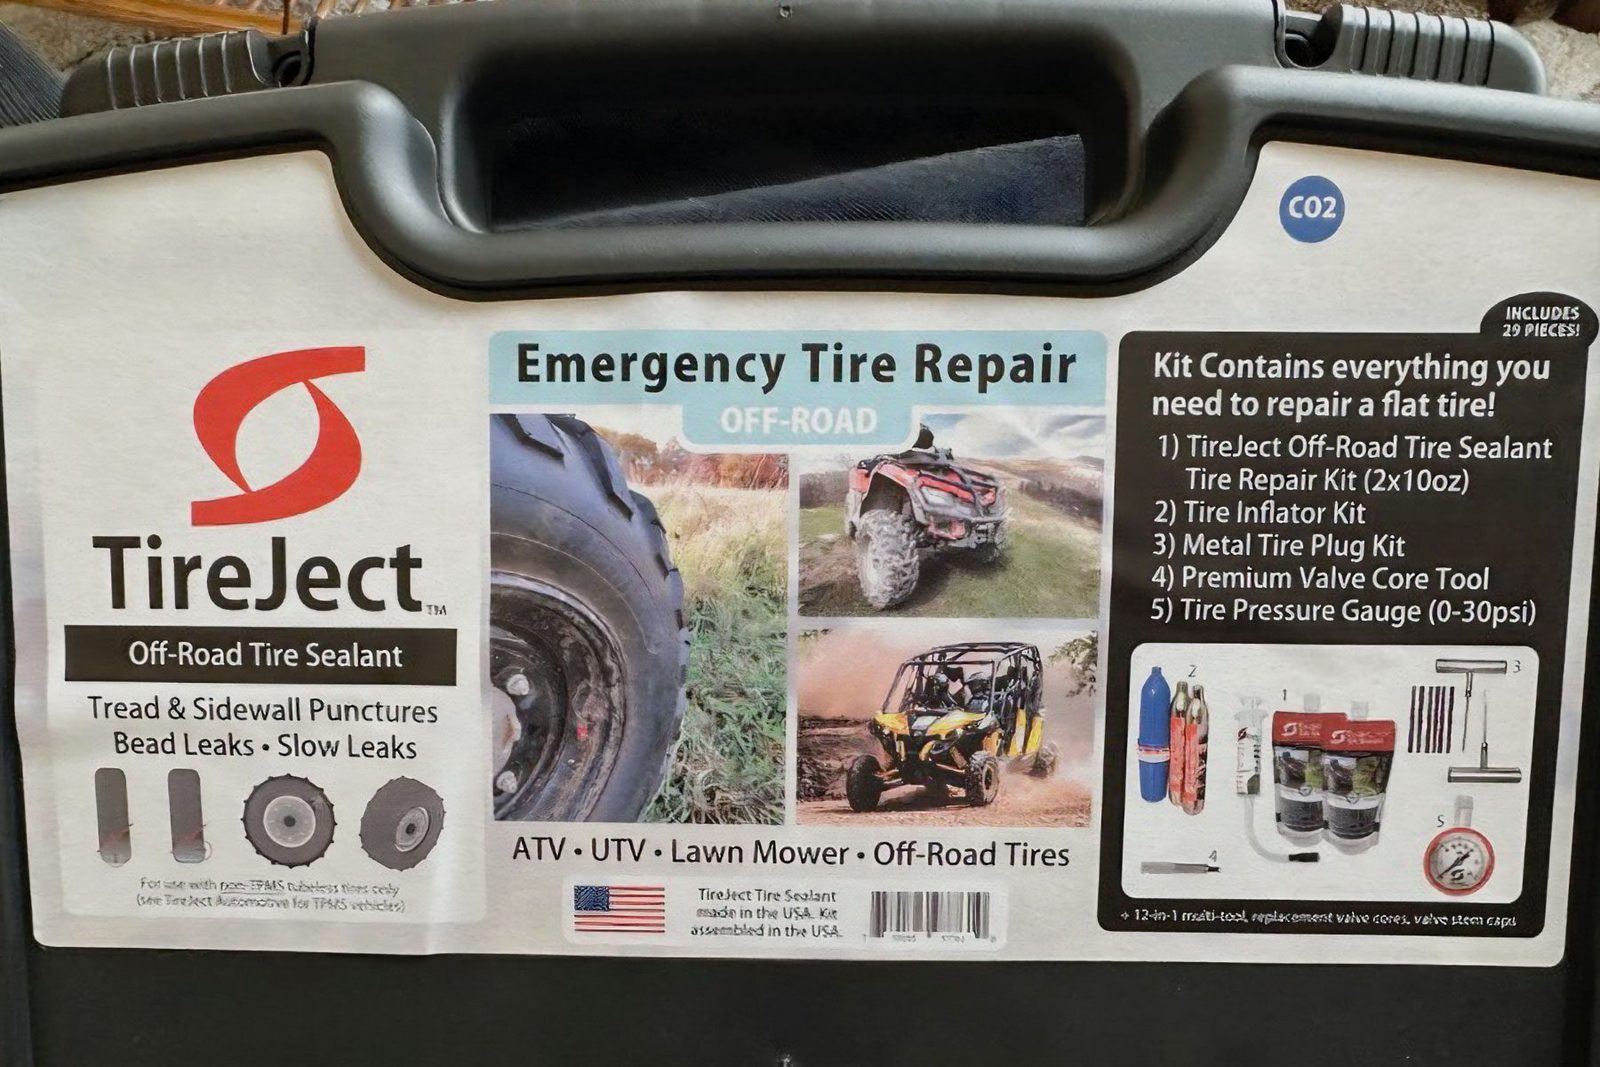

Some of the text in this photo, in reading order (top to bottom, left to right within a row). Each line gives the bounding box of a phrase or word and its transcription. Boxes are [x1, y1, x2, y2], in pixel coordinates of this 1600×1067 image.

[1288, 195, 1337, 219] CO2
[1506, 306, 1580, 321] INCLUDES
[1502, 322, 1580, 338] 29 PIECES!
[517, 343, 1077, 394] Emergency Tire Repair
[1154, 352, 1551, 387] Kit Contains everything you
[1152, 389, 1496, 422] need to repair a flat tire!
[720, 406, 878, 436] OFF-ROAD
[1158, 434, 1553, 460] 1) TireJect Off-Road Tire Sealant
[1185, 467, 1470, 496] Tire Repair Kit (2x10oz)
[1154, 500, 1366, 526] 2) Tire Inflator Kit
[1153, 533, 1406, 563] 3) Metal Tire Plug Kit
[92, 534, 422, 612] TireJect
[1151, 566, 1490, 592] 4) Premium Valve Core Tool
[1150, 598, 1537, 630] 5) Tire Pressure Gauge (0-30psi)
[128, 640, 403, 668] Off-Road Tire Sealant
[1512, 661, 1521, 674] 3
[1188, 665, 1197, 678] 2
[88, 696, 438, 723] Tread & Sidewall Punctures
[113, 732, 417, 760] Bead Leaks Slow Leaks
[513, 837, 1070, 867] ATV UTV Lawn Mower Off-Road Tires
[755, 888, 781, 902] Tire
[785, 889, 836, 902] Sealant
[740, 906, 752, 918] in
[756, 906, 779, 919] the
[691, 924, 764, 937] assembled
[768, 924, 781, 936] in
[785, 924, 807, 937] the
